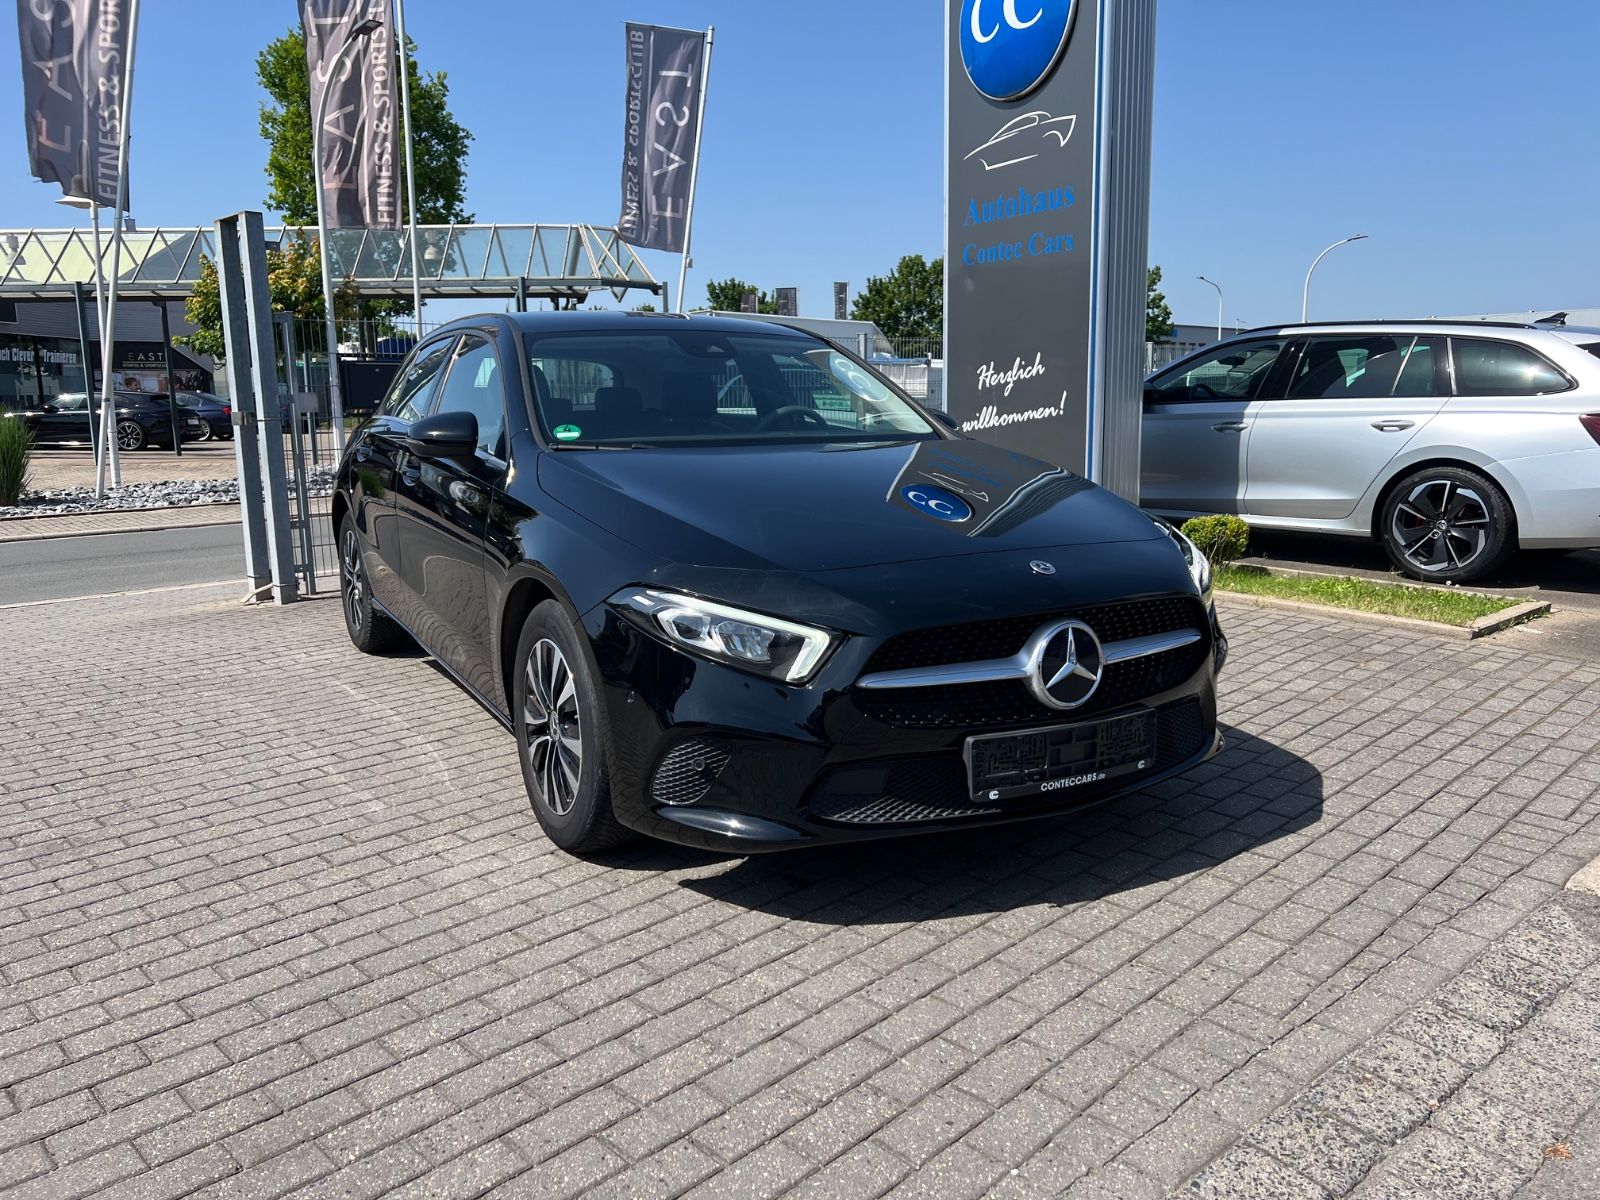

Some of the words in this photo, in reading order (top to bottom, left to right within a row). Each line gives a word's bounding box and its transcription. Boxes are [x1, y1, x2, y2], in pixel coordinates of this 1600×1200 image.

[98, 75, 120, 95] &
[308, 6, 358, 190] EAST
[373, 117, 391, 134] &
[97, 104, 120, 199] FITNESS
[374, 141, 395, 223] FITNESS
[962, 184, 1075, 226] Autohaus
[962, 240, 1023, 266] Contec
[1028, 231, 1074, 256] Cars
[128, 352, 164, 361] EAST
[976, 351, 1046, 397] Herzlich
[961, 390, 1067, 432] willkommen!
[1040, 772, 1106, 791] CONTECCARS.de
